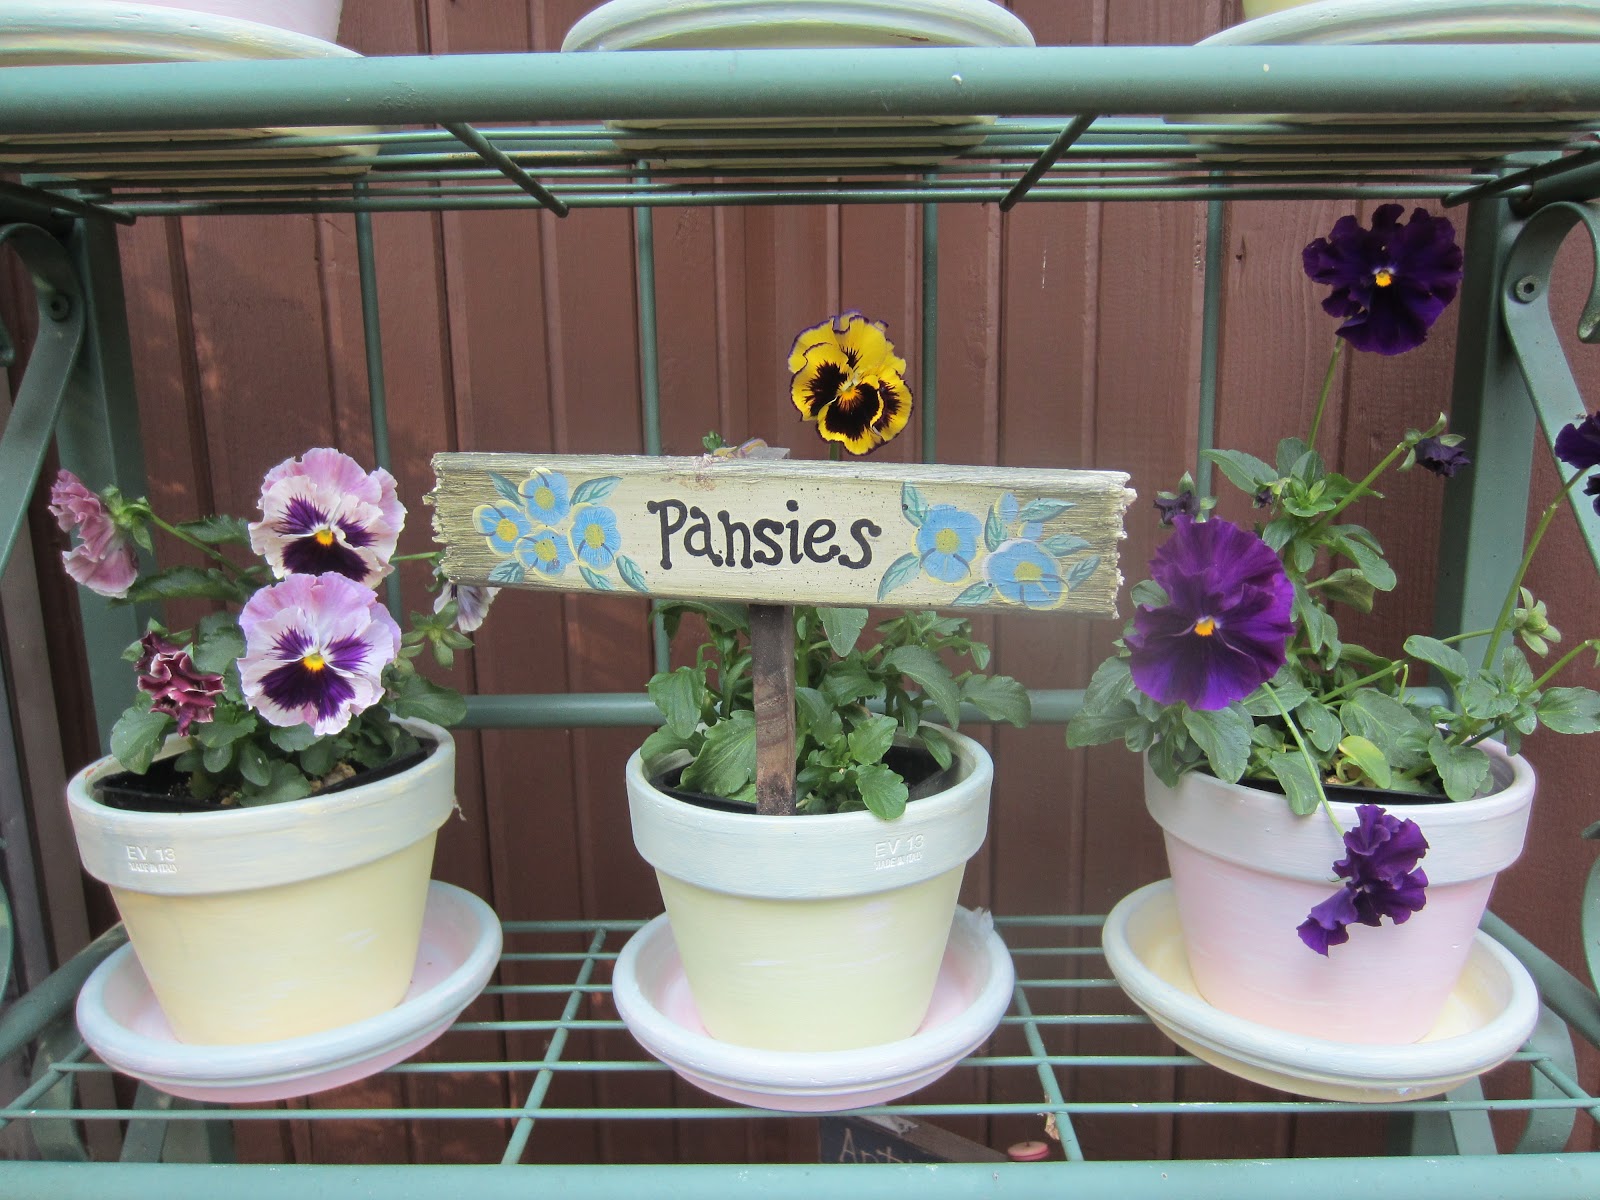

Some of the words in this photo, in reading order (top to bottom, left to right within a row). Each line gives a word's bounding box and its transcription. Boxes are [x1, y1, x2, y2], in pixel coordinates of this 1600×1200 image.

[646, 498, 883, 570] Pansies
[125, 844, 148, 861] EV
[875, 838, 901, 858] EV
[906, 834, 924, 851] 13
